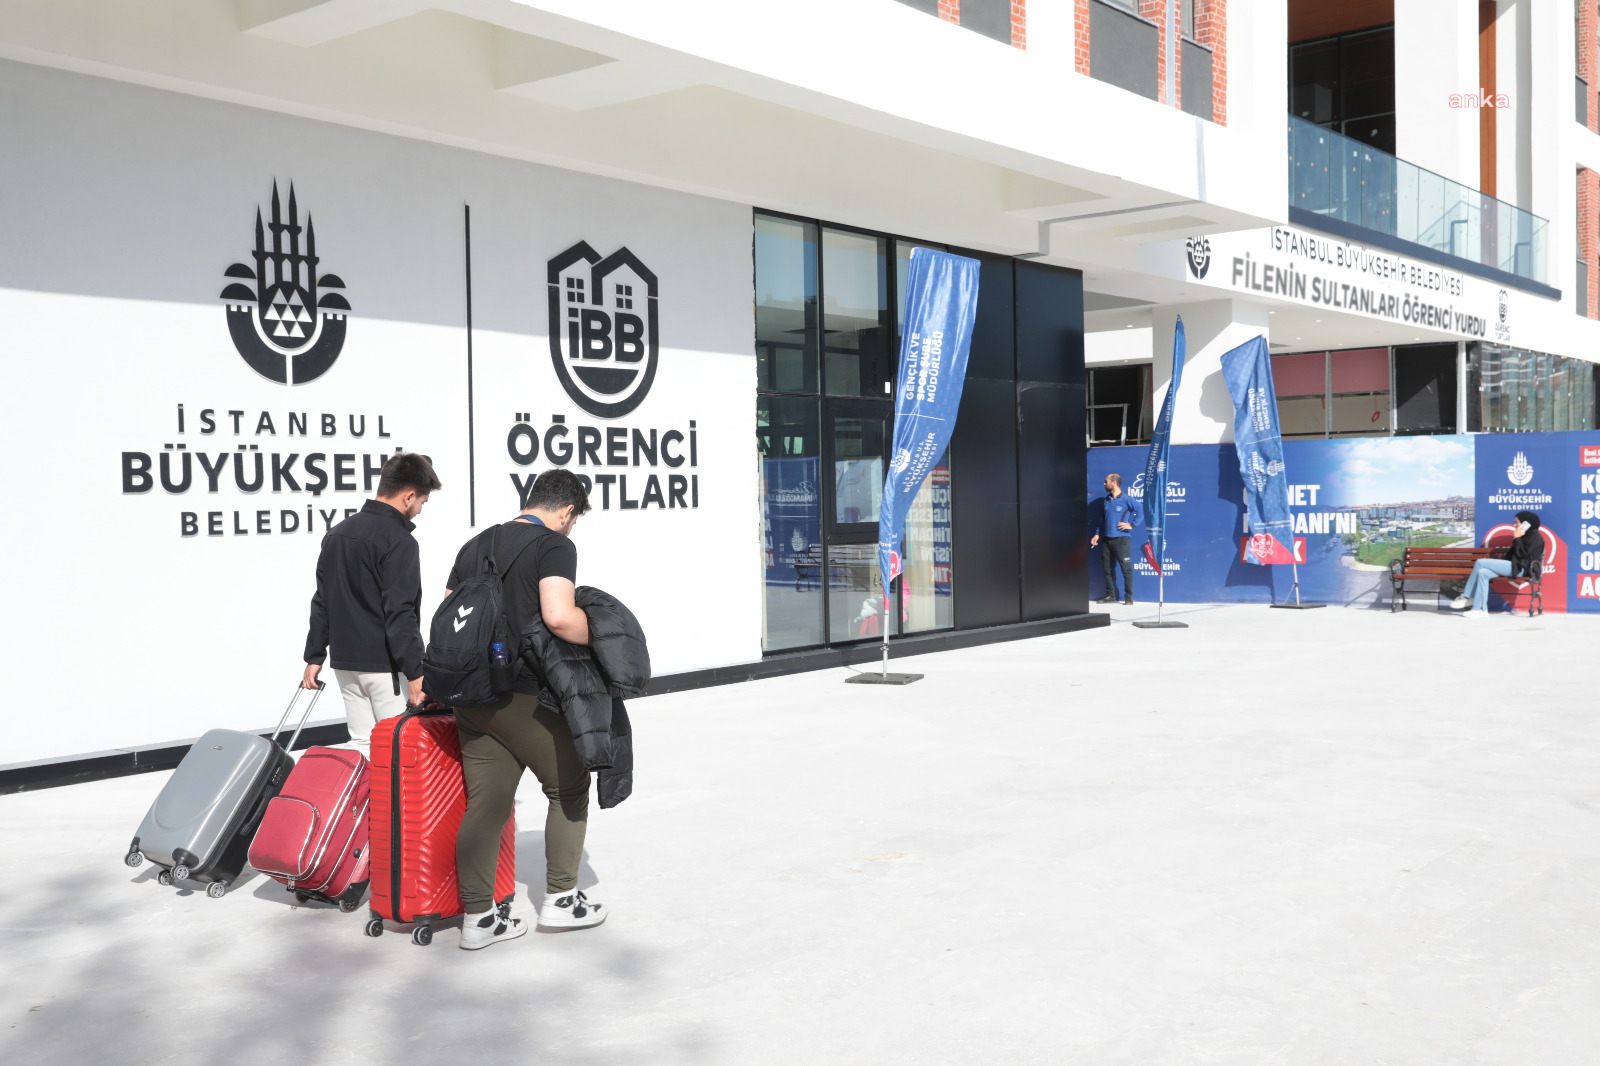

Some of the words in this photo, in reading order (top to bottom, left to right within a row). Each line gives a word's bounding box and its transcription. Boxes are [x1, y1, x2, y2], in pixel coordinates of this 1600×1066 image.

[1232, 251, 1306, 300] FİLENİN
[1311, 276, 1399, 319] SULTANLARI
[1402, 292, 1453, 330] ÖĞRENCİ
[1454, 311, 1487, 337] YURDU
[911, 332, 921, 349] VE
[920, 337, 933, 368] ŞUBE
[906, 350, 920, 401] GENÇLİK
[917, 370, 929, 401] SPOR
[926, 330, 944, 403] MÜDÜRLÜĞÜ
[177, 403, 391, 437] İSTANBUL
[507, 412, 698, 468] ÖĞRENCİ
[121, 443, 433, 496] BÜYÜKŞEH
[902, 441, 924, 485] İSTANBUL
[509, 473, 699, 510] YTLARI
[180, 504, 358, 536] BELEDİY
